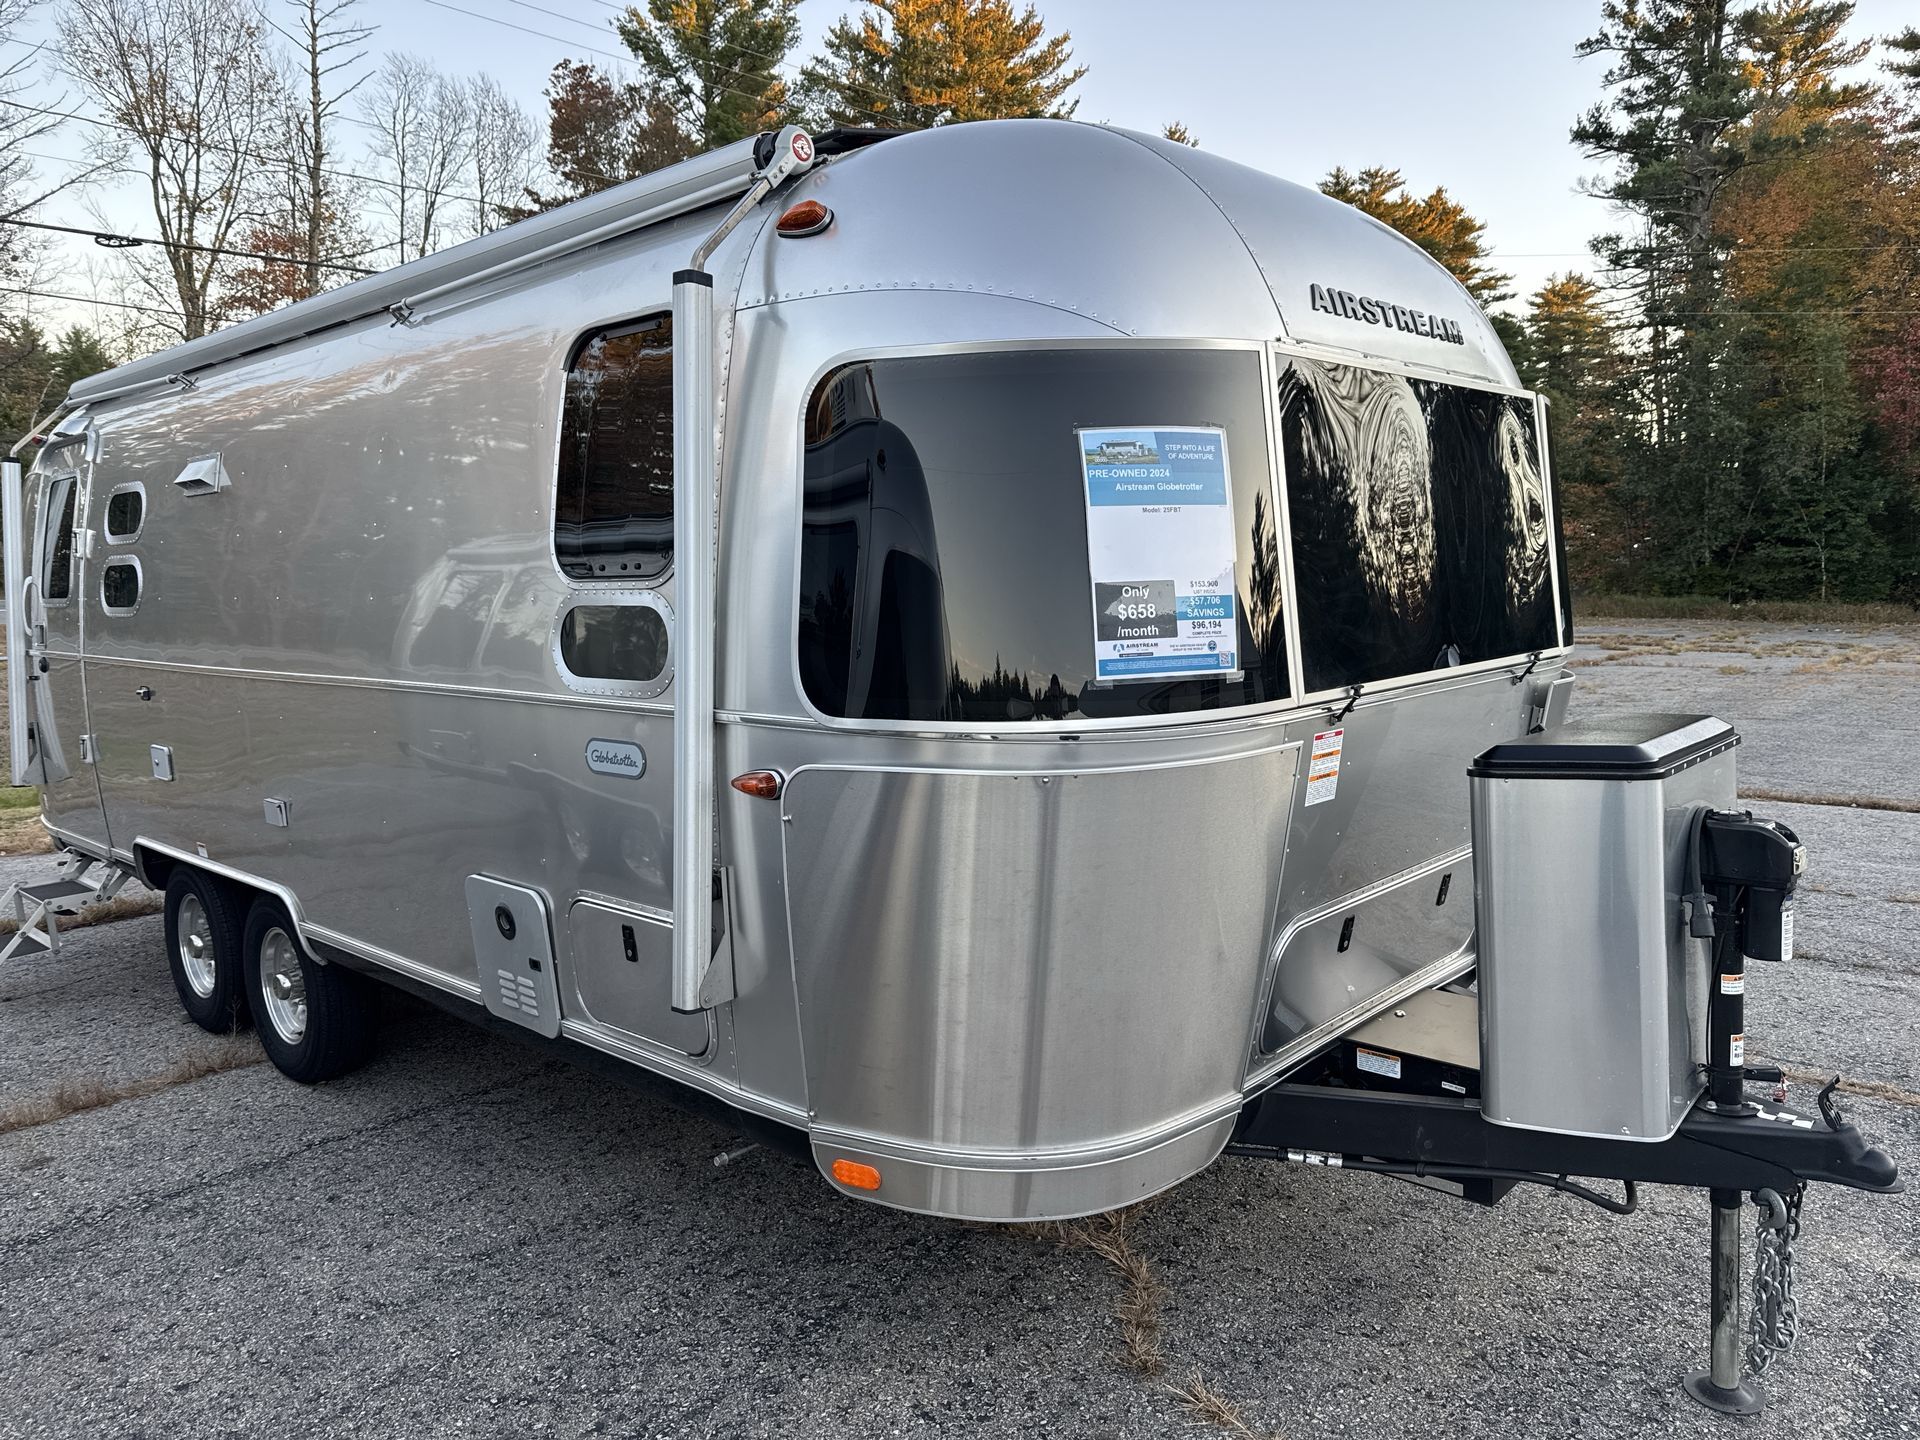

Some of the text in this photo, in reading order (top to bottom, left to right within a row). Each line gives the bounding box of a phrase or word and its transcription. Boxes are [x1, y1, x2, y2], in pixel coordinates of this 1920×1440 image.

[1309, 283, 1464, 346] AIRSTREAM
[1182, 444, 1197, 452] INTO
[1089, 468, 1170, 478] PRE-OWNED 2024
[1115, 482, 1204, 491] Airstream Globetrotter
[1122, 586, 1150, 600] Only
[1190, 596, 1221, 606] $57,706
[1117, 603, 1156, 621] $658
[1187, 608, 1225, 617] SAVINGS
[1191, 620, 1222, 630] $96,194
[1117, 625, 1159, 637] /month
